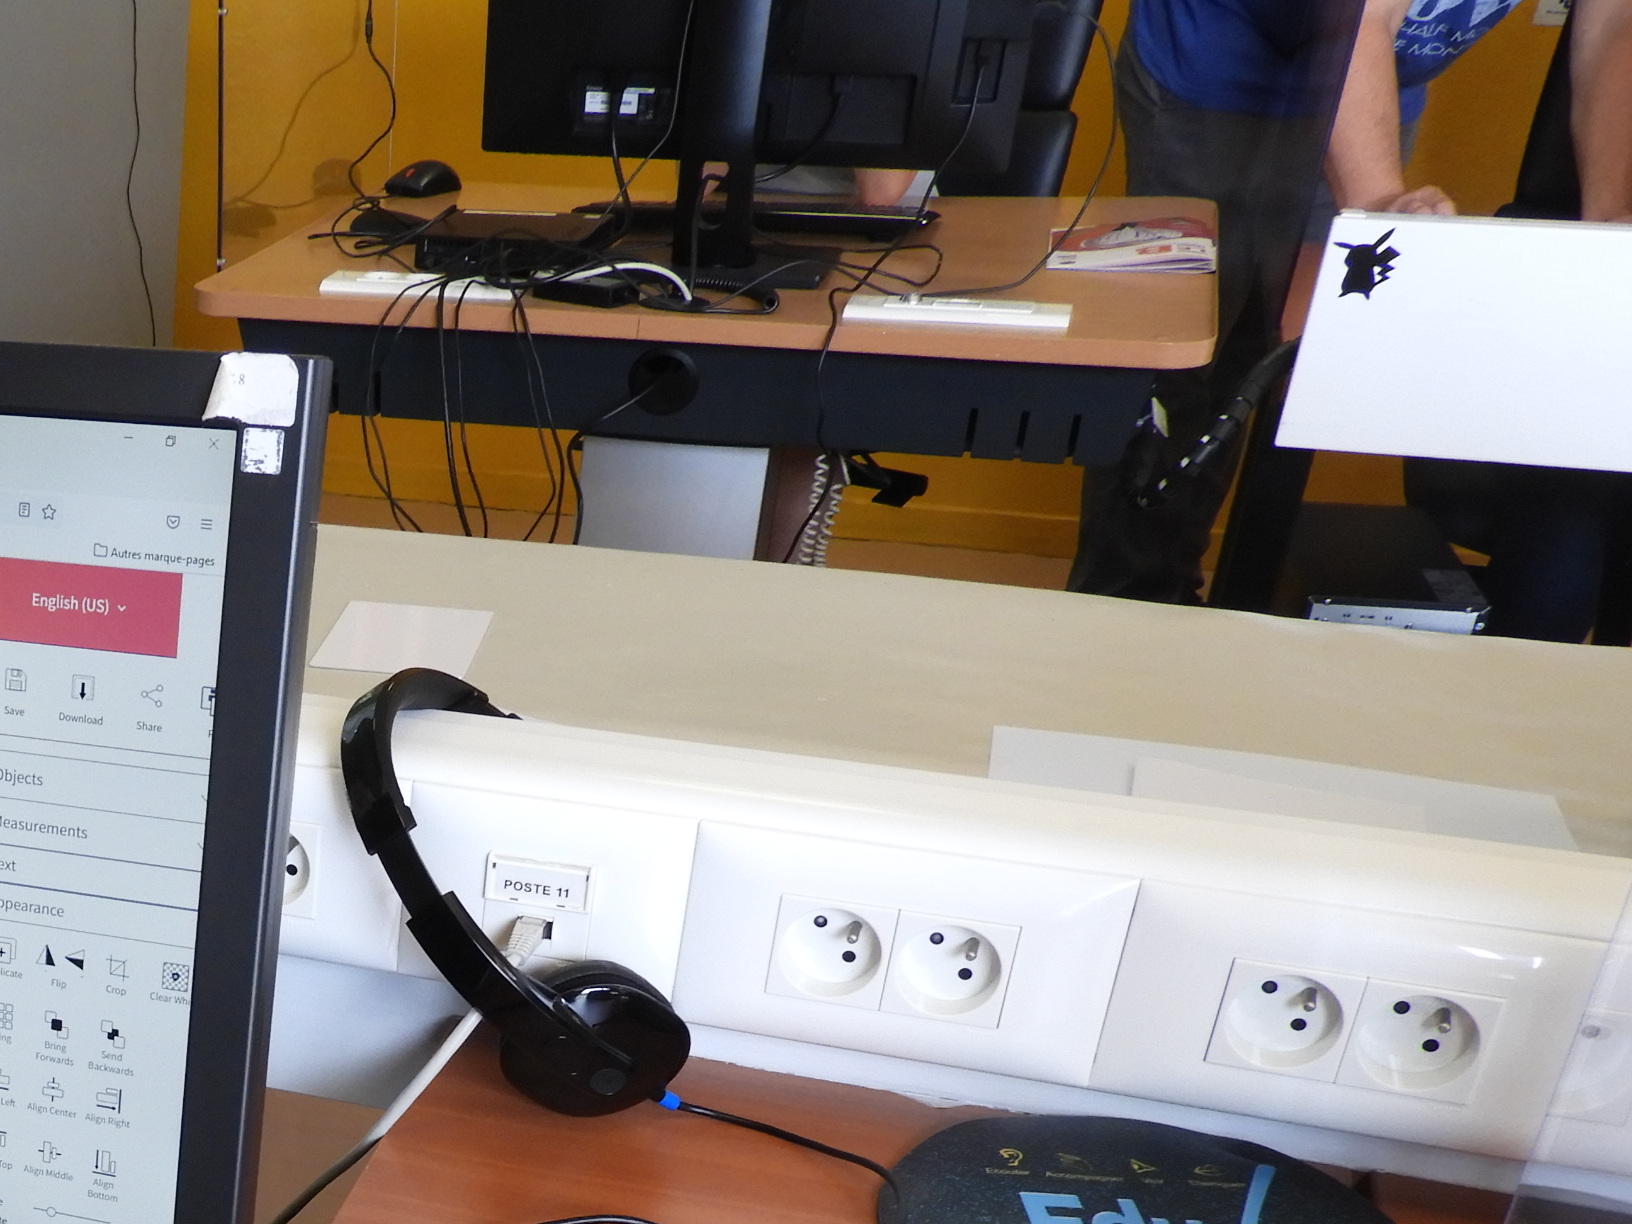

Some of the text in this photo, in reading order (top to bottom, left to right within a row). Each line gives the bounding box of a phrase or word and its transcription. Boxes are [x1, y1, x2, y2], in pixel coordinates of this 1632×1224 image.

[110, 547, 215, 568] Autres marque-pages
[31, 593, 110, 616] English (US)
[4, 704, 25, 718] Save
[58, 711, 104, 727] Download
[135, 720, 163, 733] Share
[503, 879, 570, 899] POSTE 11
[50, 978, 67, 990] Flip
[105, 984, 127, 997] Crop
[149, 991, 172, 1004] Clear
[44, 1040, 67, 1054] Bring
[35, 1051, 74, 1067] Forwards
[101, 1050, 123, 1062] Send
[87, 1061, 135, 1077] Backwards
[0, 1096, 16, 1108] Left
[26, 1102, 77, 1119] Align Center
[84, 1112, 131, 1129] Align Right
[23, 1164, 74, 1182] Align Middle
[92, 1178, 114, 1190] Align
[87, 1189, 118, 1203] Bottom
